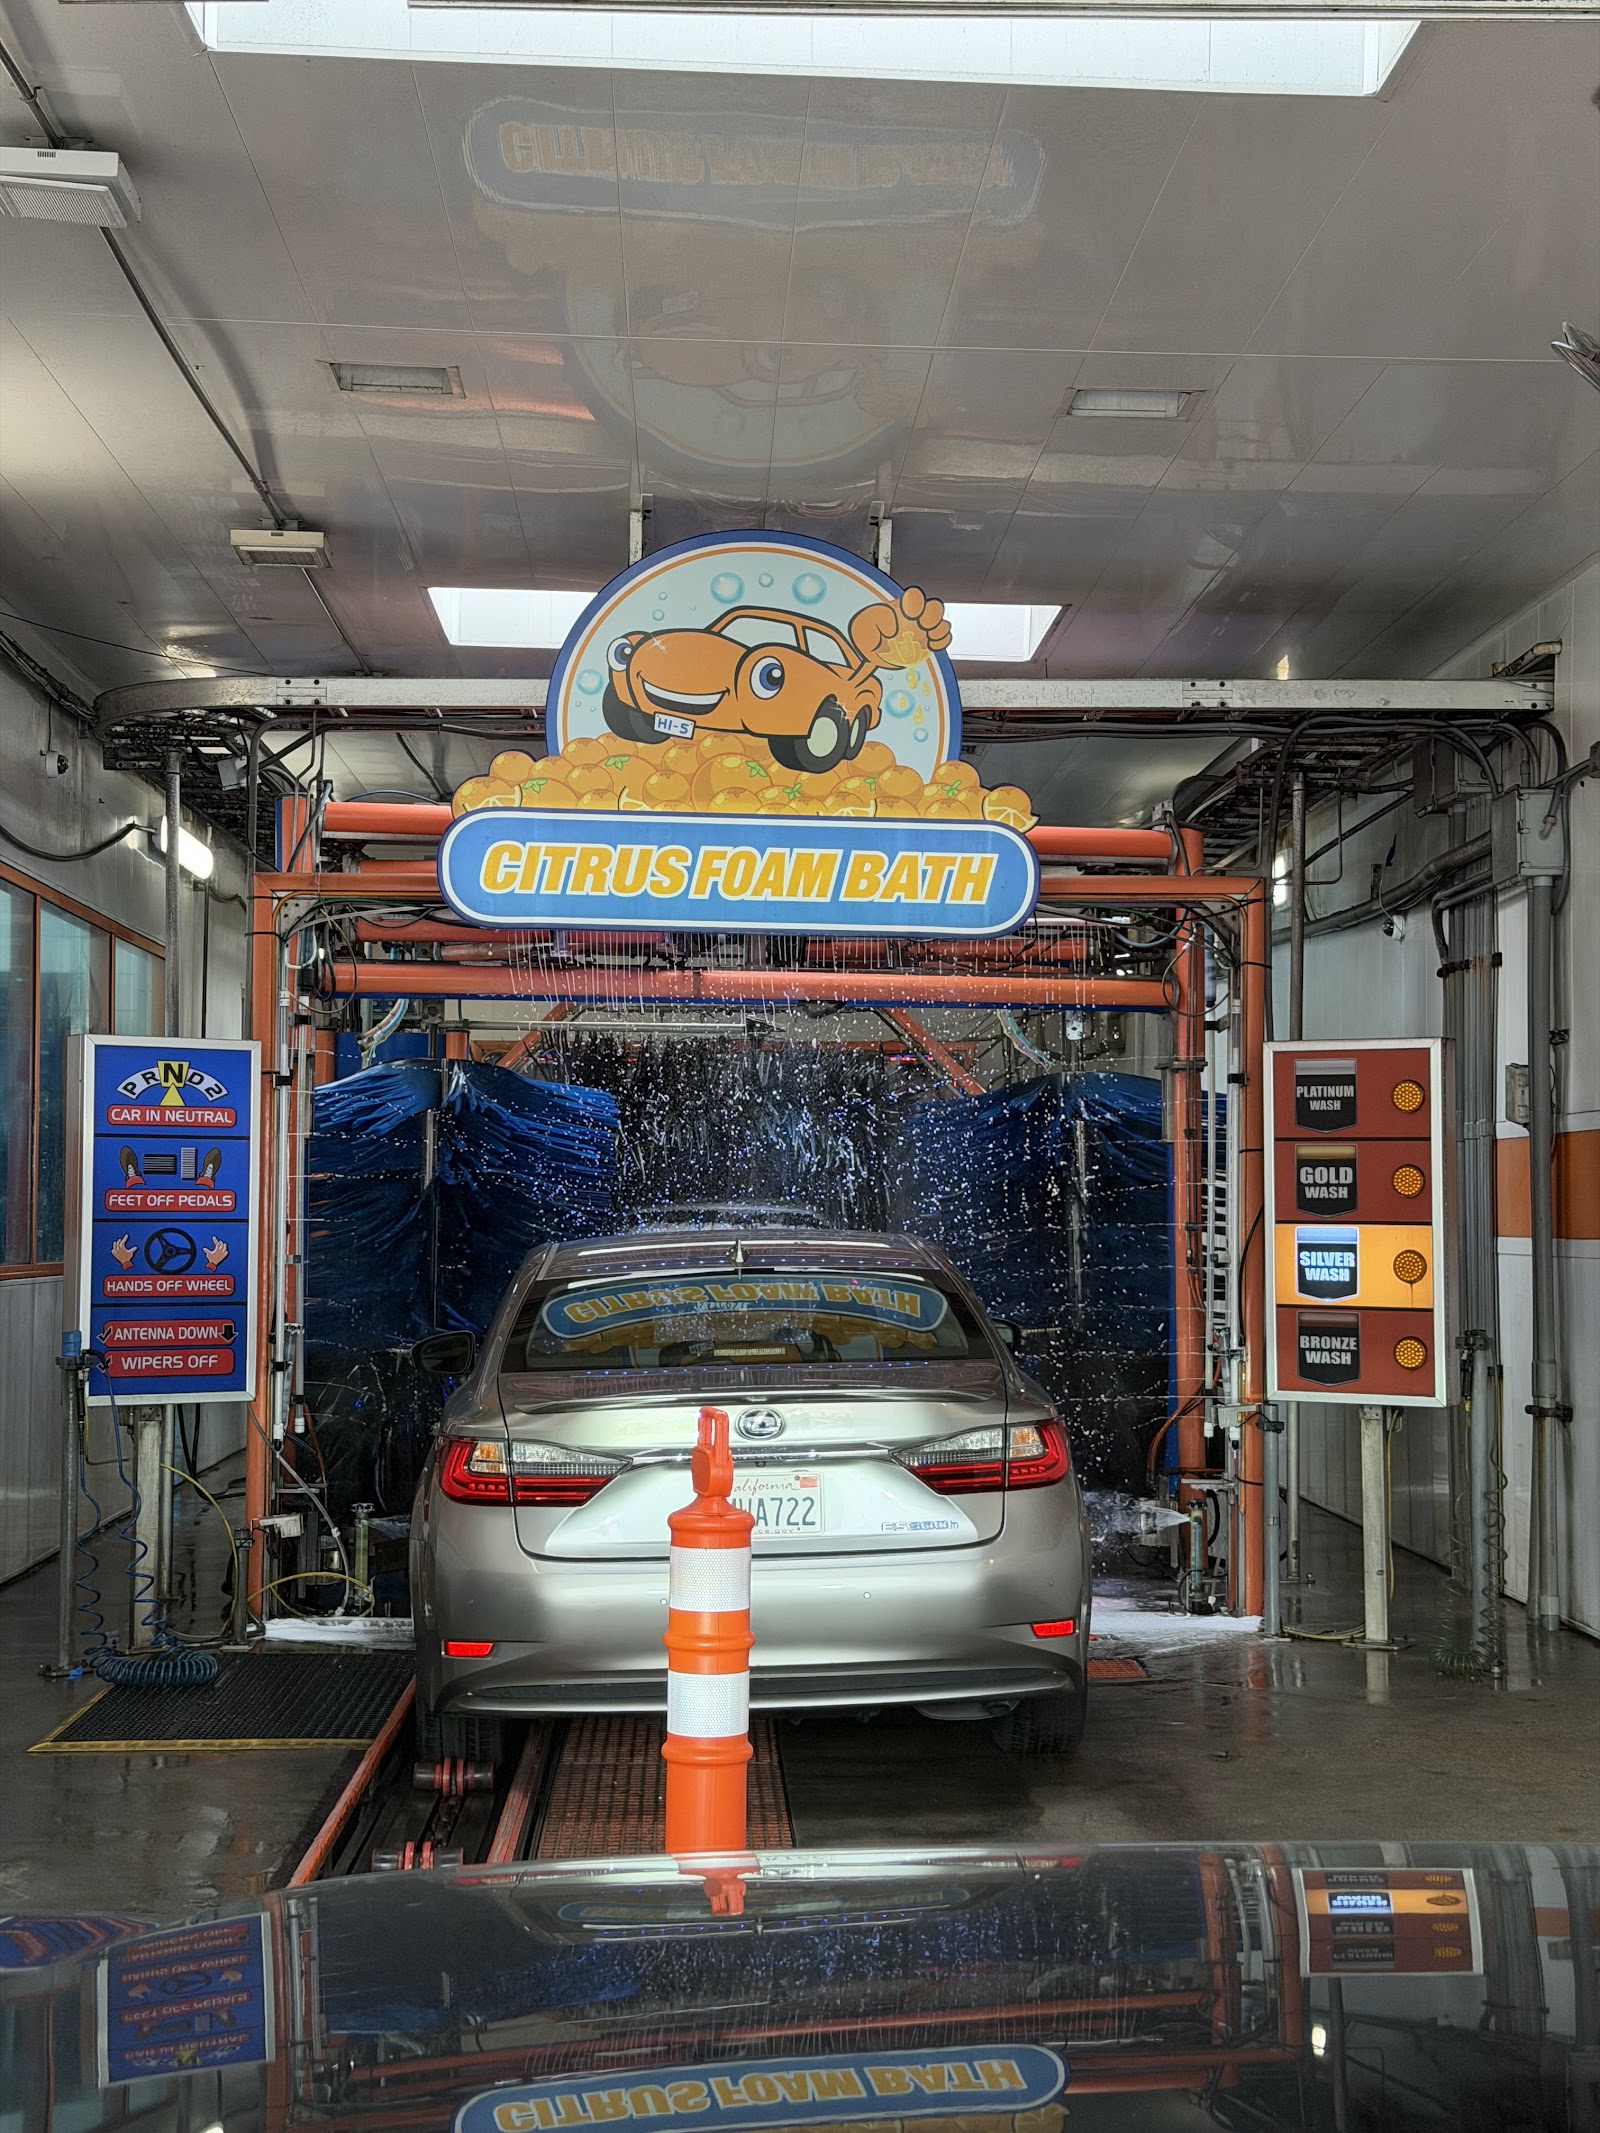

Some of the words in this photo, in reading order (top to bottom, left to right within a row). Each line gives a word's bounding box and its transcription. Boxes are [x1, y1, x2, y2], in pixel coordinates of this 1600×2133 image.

[657, 717, 690, 735] HI-5
[479, 840, 690, 897] CITRUS
[688, 846, 843, 902] FOAM
[838, 852, 999, 905] BATH
[1296, 1085, 1354, 1098] PLATINUM
[1309, 1100, 1341, 1111] WASH
[111, 1108, 142, 1121] CAR
[145, 1109, 161, 1122] IN
[165, 1110, 233, 1124] NEUTRAL
[1300, 1166, 1353, 1184] GOLD
[1304, 1186, 1348, 1199] WASH
[109, 1194, 144, 1207] FEET
[147, 1194, 175, 1207] OFF
[178, 1194, 233, 1208] PEDALS
[1299, 1251, 1355, 1268] SILVER
[1304, 1268, 1350, 1282] WASH
[106, 1280, 153, 1292] HANDS
[156, 1280, 183, 1292] OFF
[186, 1279, 232, 1292] WHEEL
[114, 1326, 175, 1341] ANTENNA
[178, 1326, 218, 1340] DOWN
[1299, 1336, 1357, 1350] BRONZE
[121, 1356, 183, 1370] WIPERS
[189, 1355, 218, 1369] OFF
[1304, 1351, 1351, 1366] WASH
[734, 1478, 800, 1496] alifornia
